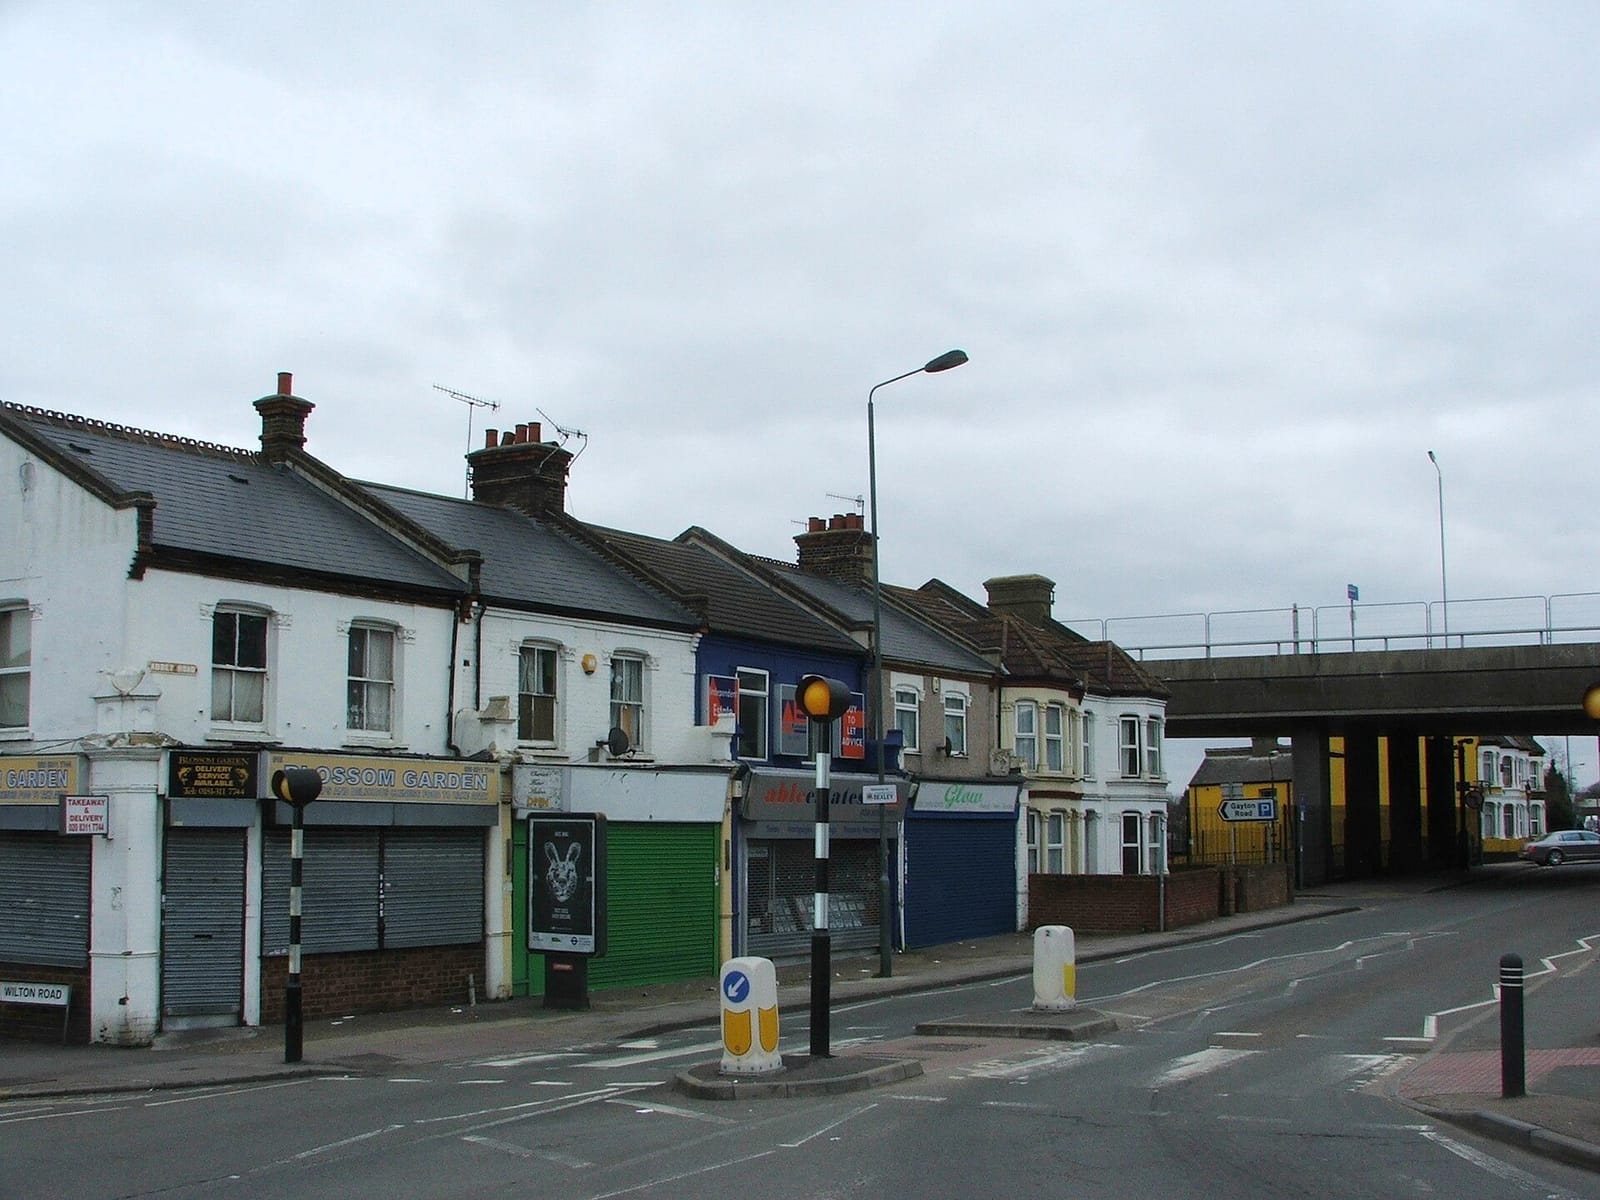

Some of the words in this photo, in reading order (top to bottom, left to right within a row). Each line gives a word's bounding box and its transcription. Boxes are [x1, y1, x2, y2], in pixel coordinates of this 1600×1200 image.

[847, 715, 856, 724] TO
[846, 726, 856, 735] LET
[842, 737, 863, 747] ADVICE
[6, 769, 68, 788] GARDEN
[284, 764, 396, 787] OSSOM
[403, 769, 488, 791] GARDEN
[944, 784, 984, 809] Glow
[4, 986, 35, 998] WILTON
[38, 988, 62, 999] ROAD
